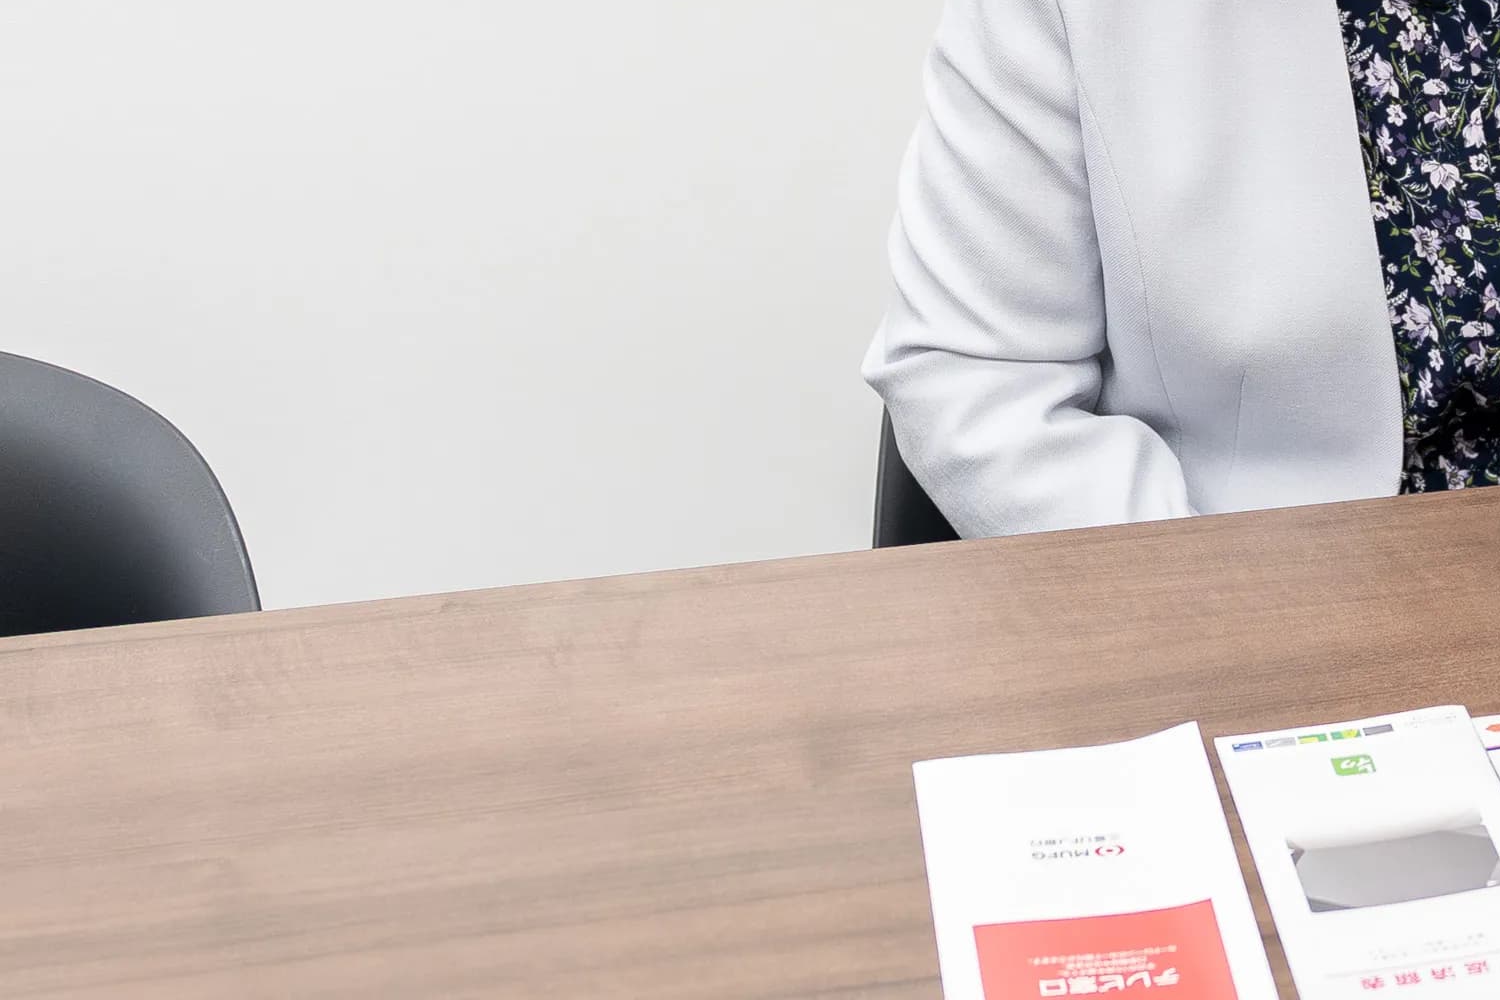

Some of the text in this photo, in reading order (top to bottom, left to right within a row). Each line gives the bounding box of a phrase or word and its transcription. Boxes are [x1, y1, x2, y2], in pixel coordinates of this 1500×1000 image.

[1031, 848, 1089, 860] MUFG
[1039, 968, 1180, 997] テレビ窓口
